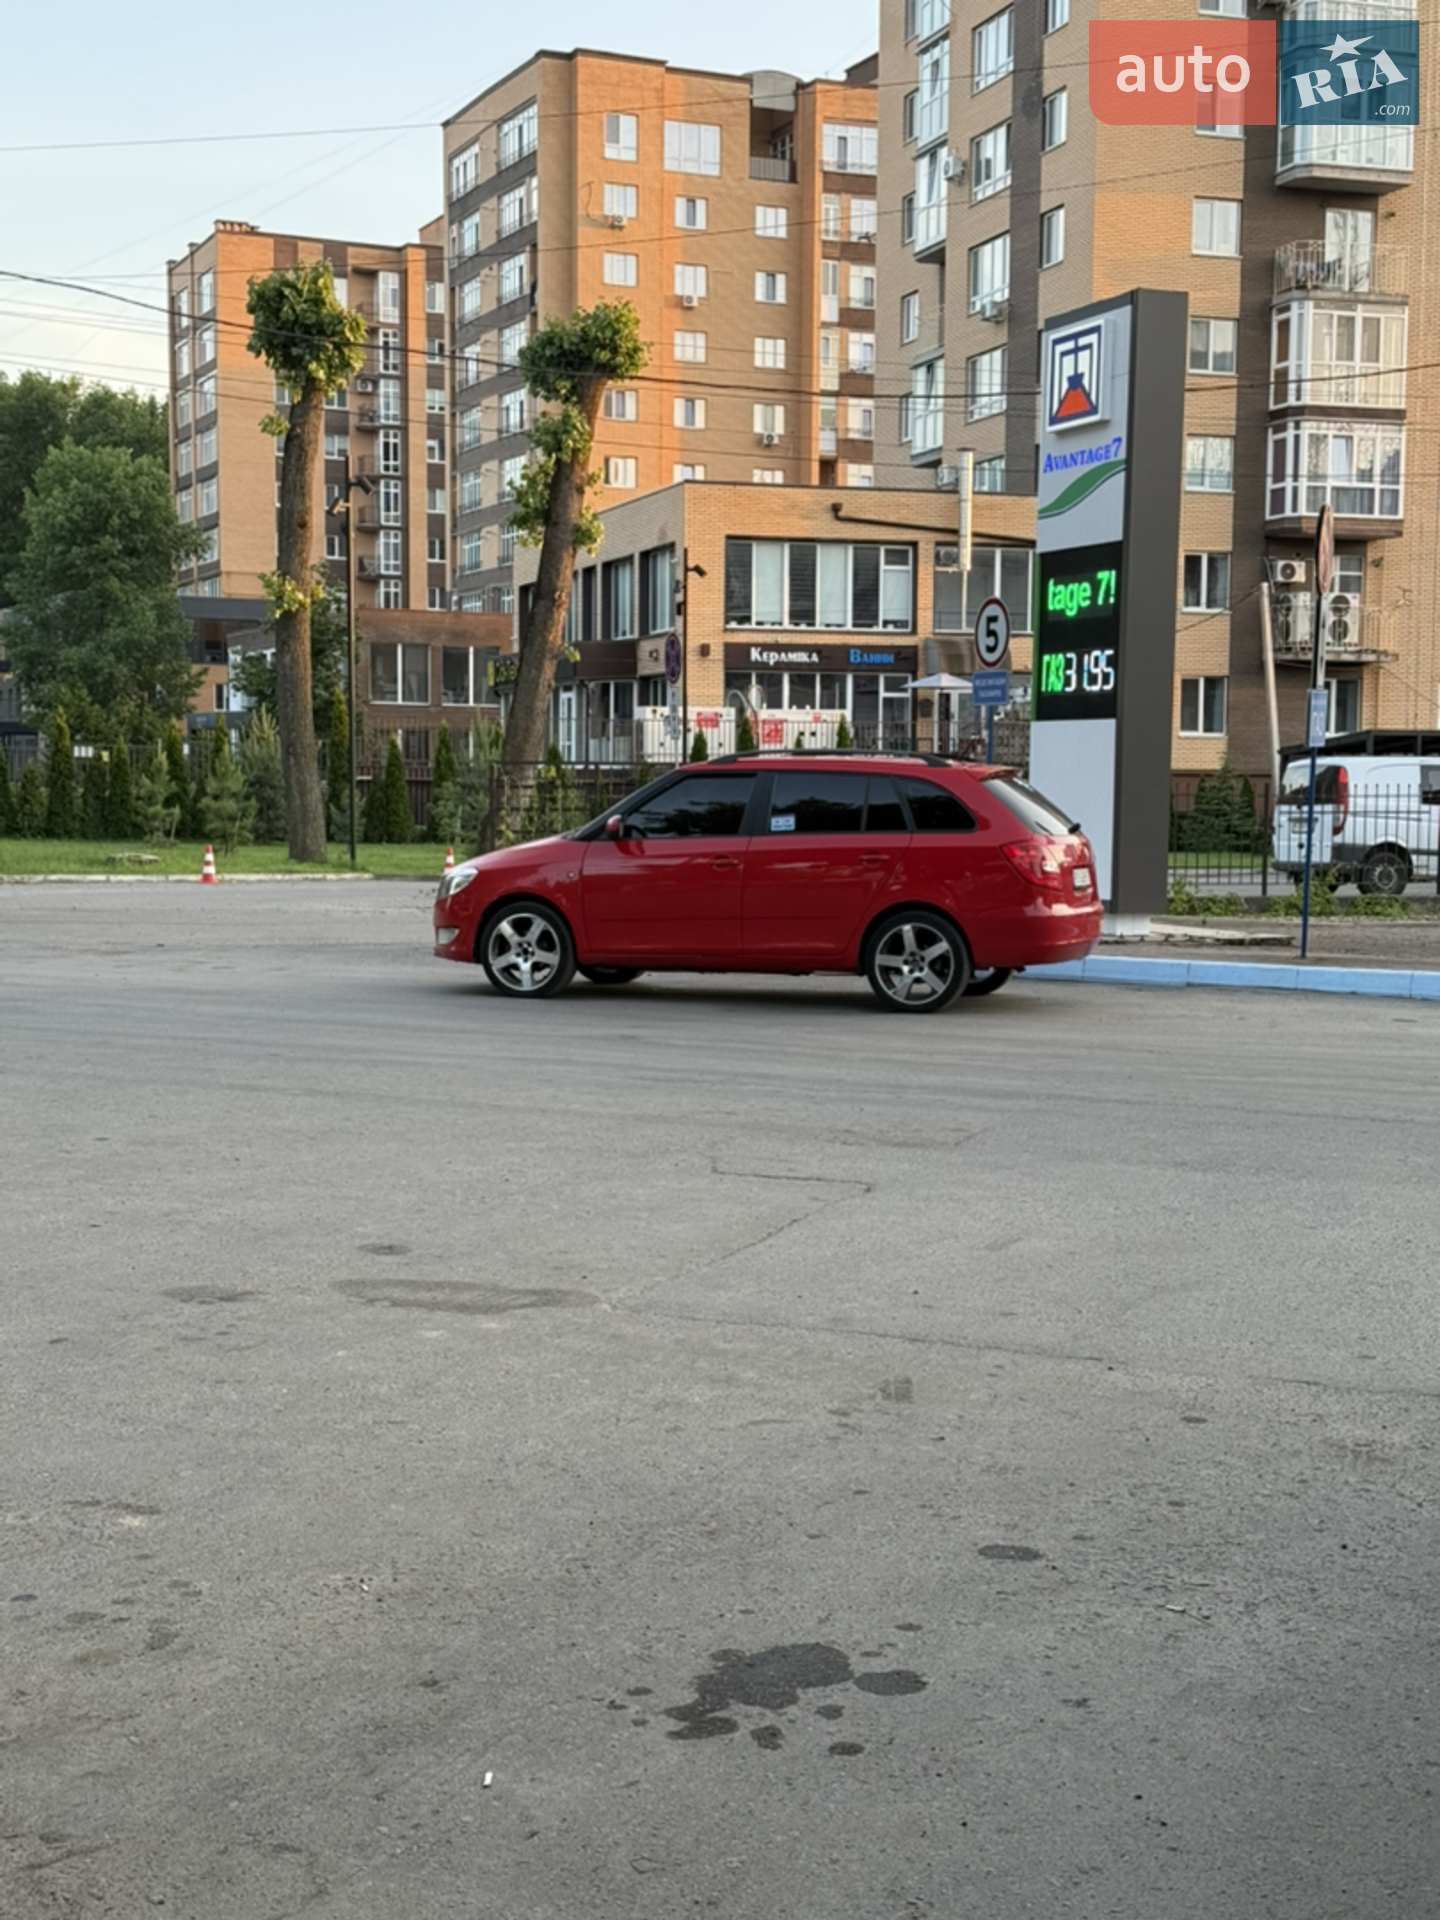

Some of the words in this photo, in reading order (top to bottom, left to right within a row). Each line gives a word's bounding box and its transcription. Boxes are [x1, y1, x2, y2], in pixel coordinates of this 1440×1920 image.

[1047, 577, 1092, 617] tage
[1096, 569, 1116, 606] 7!
[985, 614, 999, 654] 5
